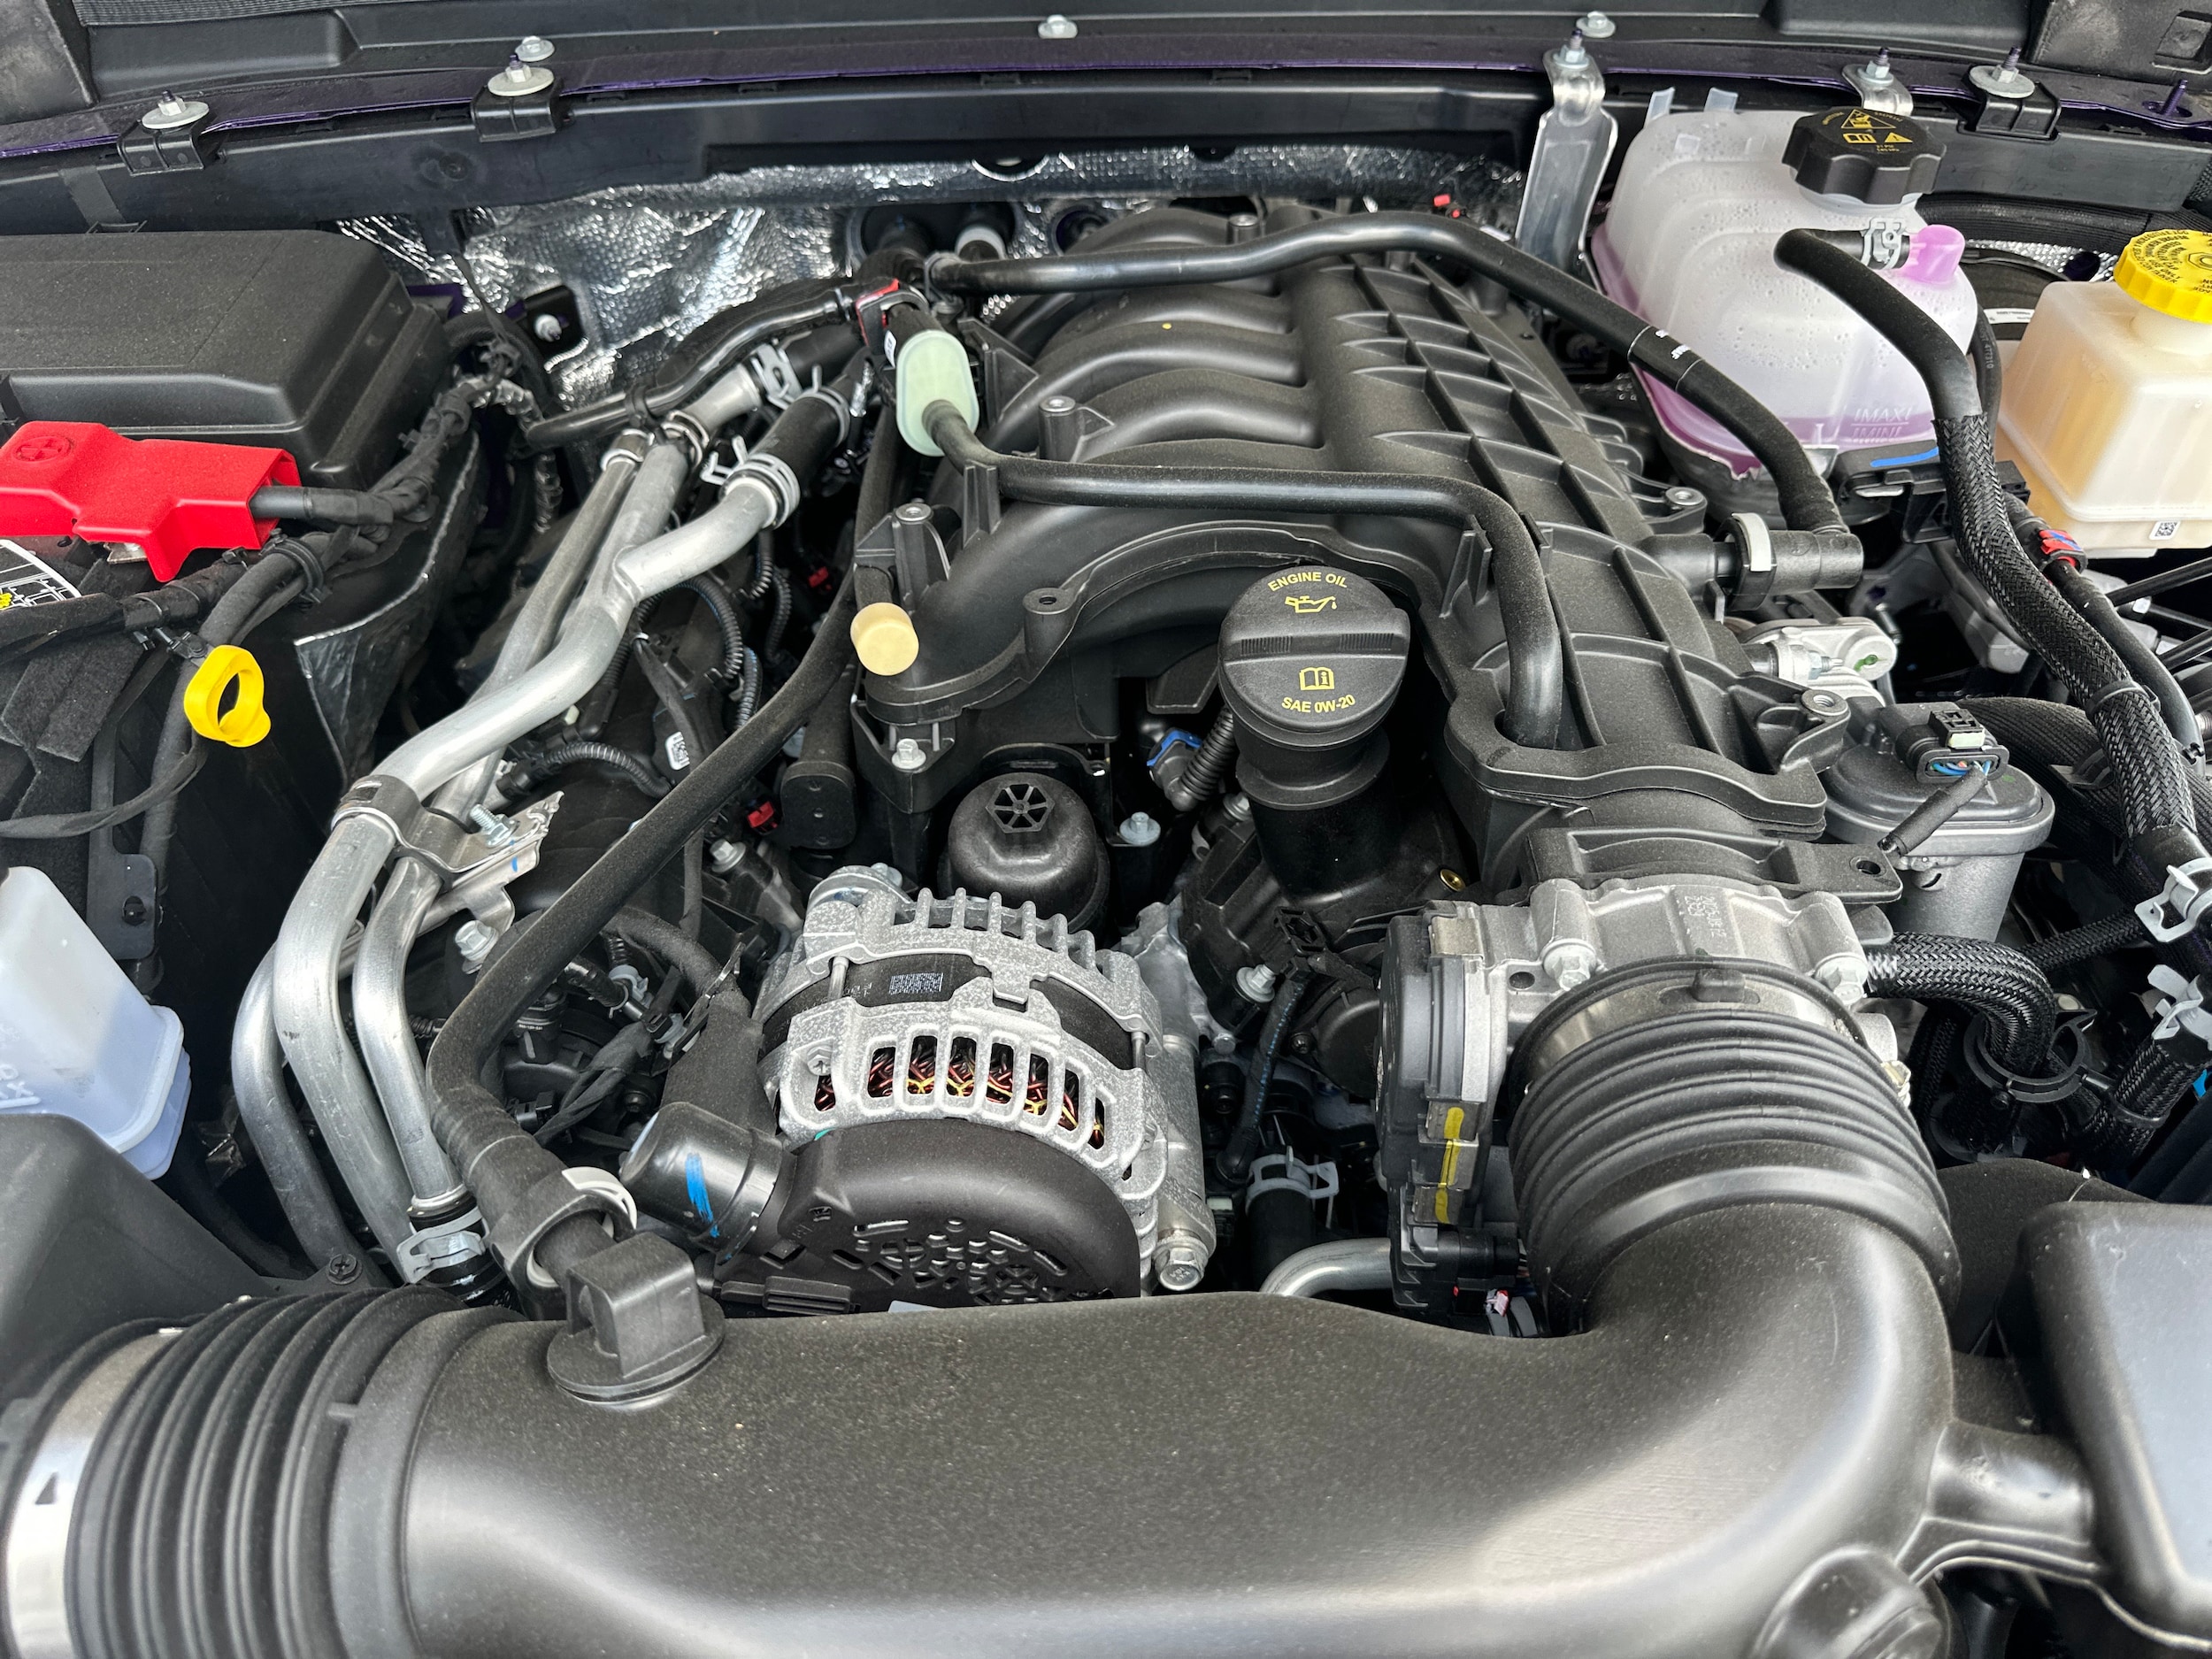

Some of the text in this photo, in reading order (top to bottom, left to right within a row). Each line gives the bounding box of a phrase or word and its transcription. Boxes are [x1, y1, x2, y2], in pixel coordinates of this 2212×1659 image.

[1268, 572, 1348, 591] ENGINE OIL
[1282, 695, 1356, 713] SAE 0W-20
